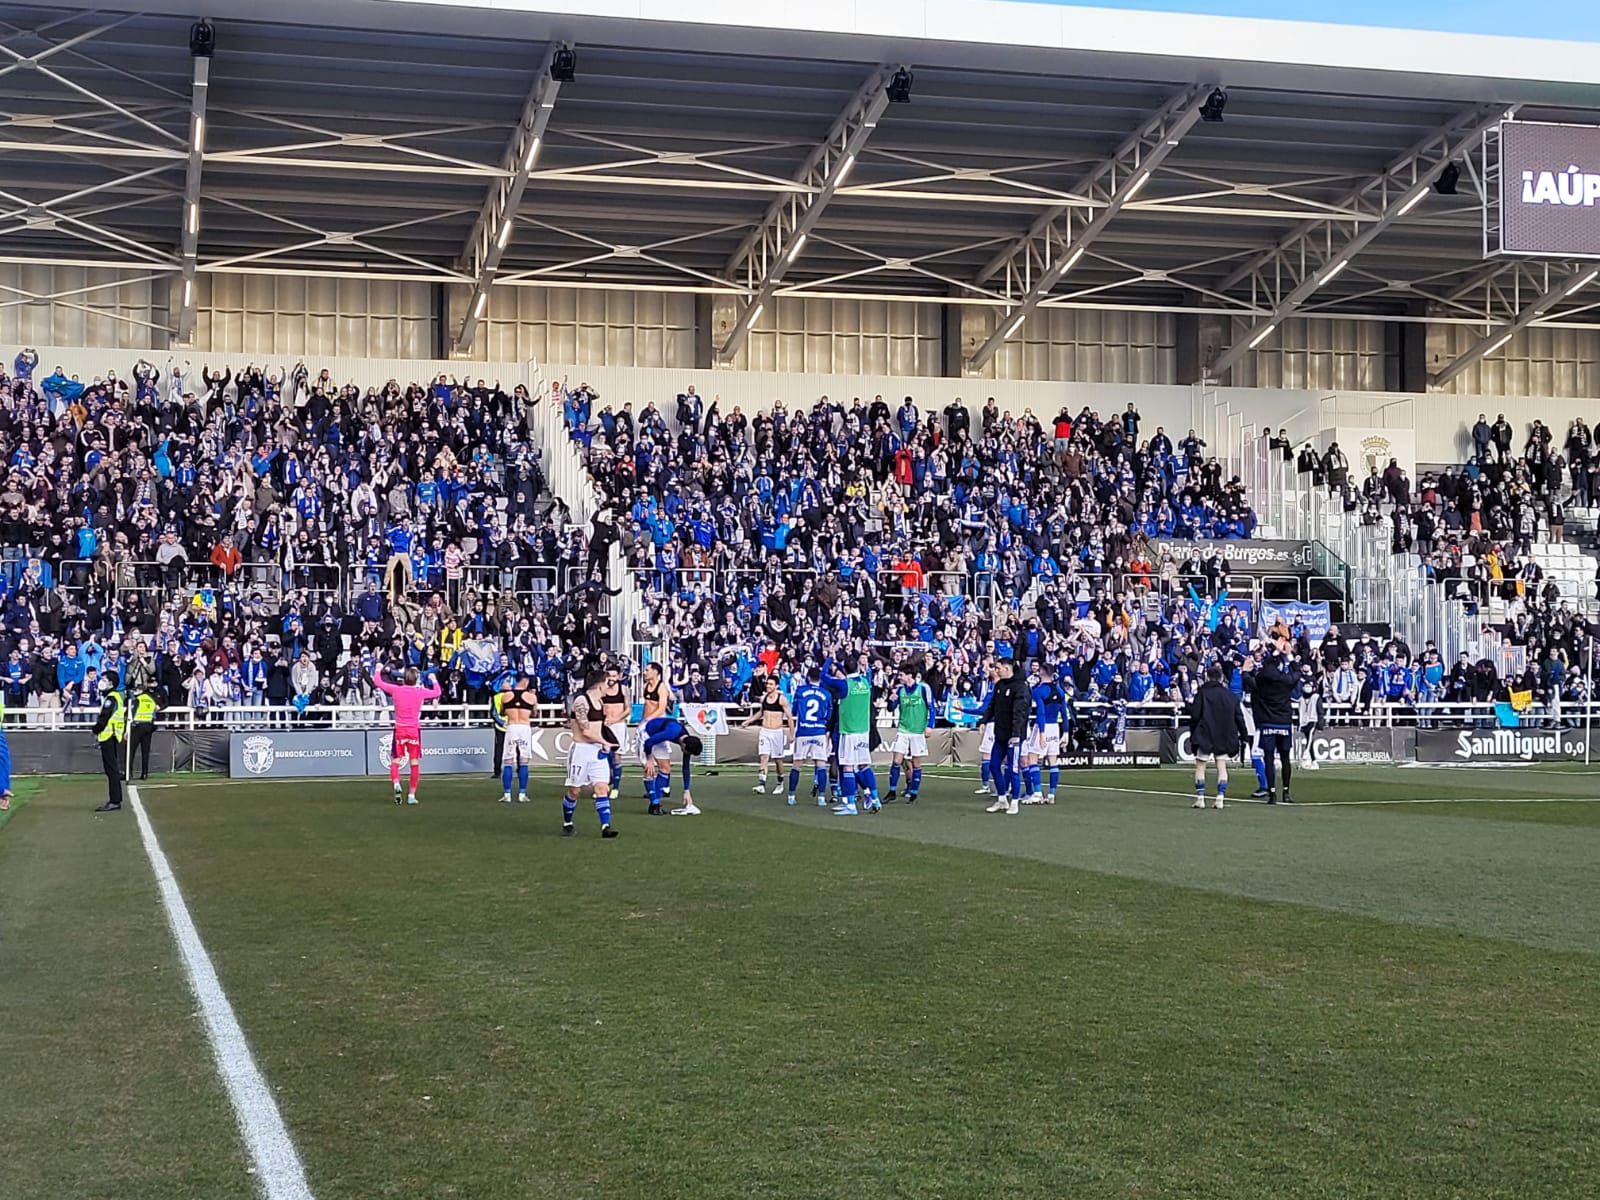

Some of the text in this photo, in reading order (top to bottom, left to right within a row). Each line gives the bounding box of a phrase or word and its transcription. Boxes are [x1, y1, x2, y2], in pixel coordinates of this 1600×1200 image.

[805, 699, 820, 721] 2
[1455, 729, 1585, 760] SanMiguel 0,0
[1346, 751, 1391, 761] INMOBILIARIA
[572, 764, 582, 775] 17
